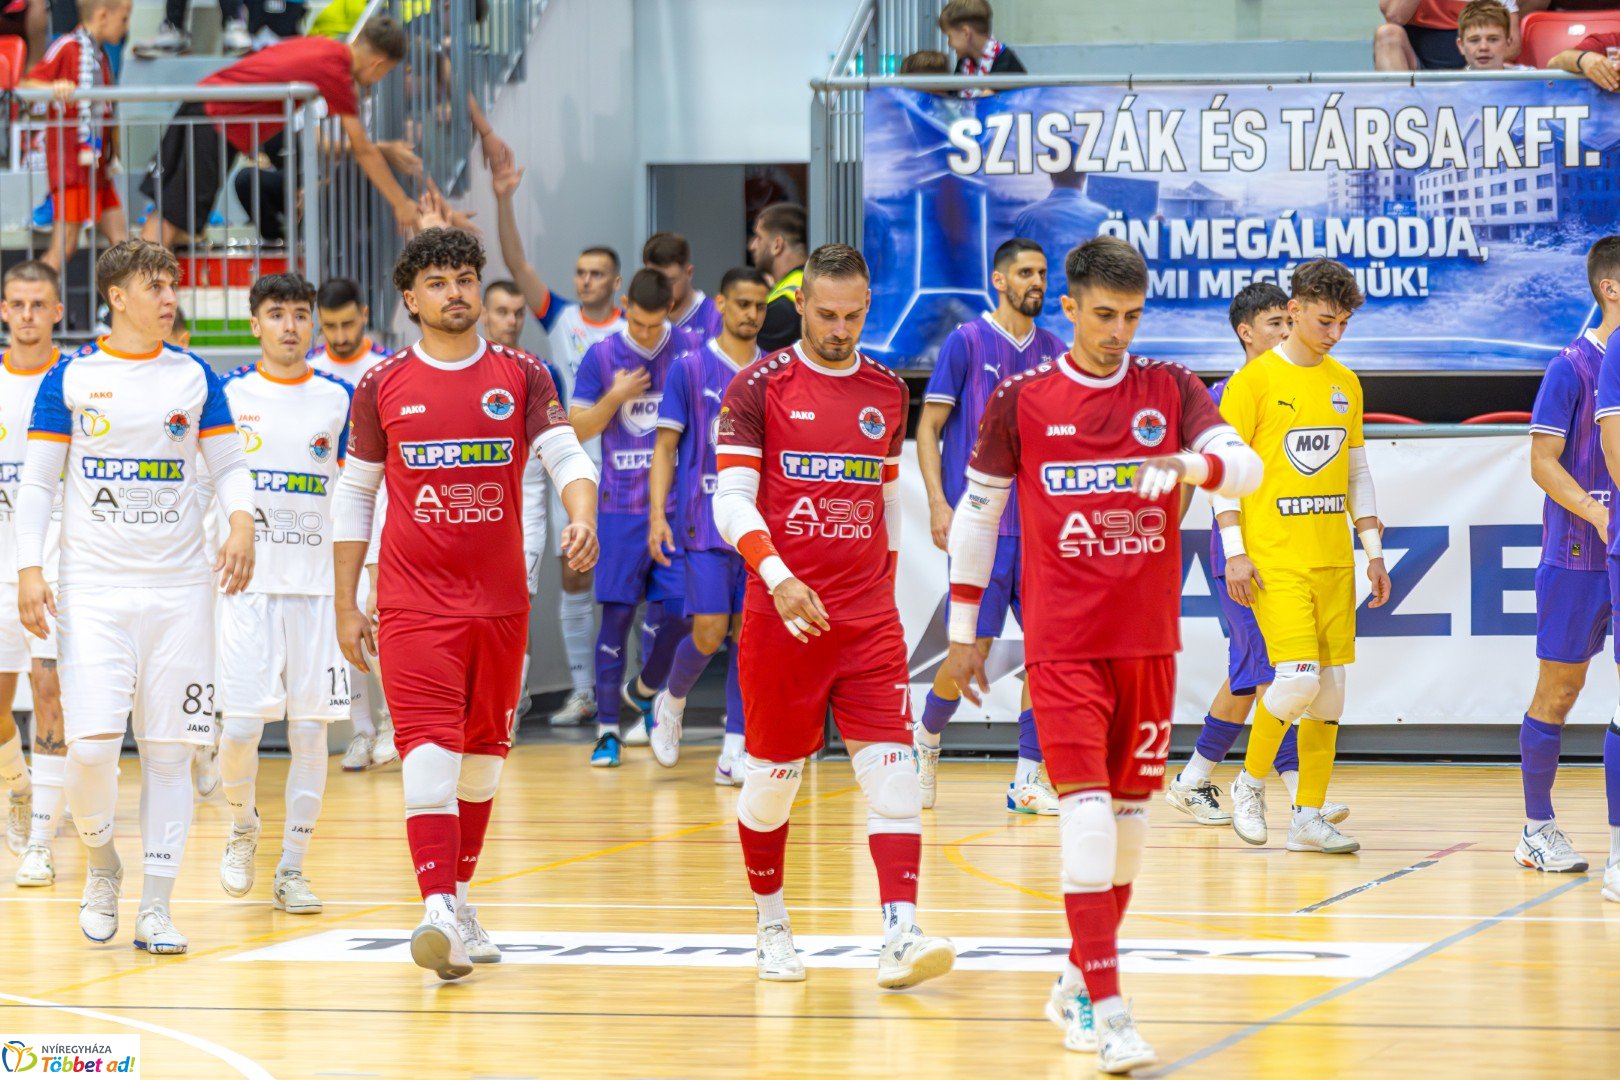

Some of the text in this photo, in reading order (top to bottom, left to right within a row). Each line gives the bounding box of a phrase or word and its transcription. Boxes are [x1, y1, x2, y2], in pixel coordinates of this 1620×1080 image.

[948, 92, 1601, 175] SZISZÁK ÉS TÁRSA KFT.
[1170, 209, 1489, 263] MEGÁLMODJA,
[89, 391, 113, 400] JAKO
[238, 414, 261, 422] JAKO
[401, 404, 427, 416] JAKO
[790, 410, 816, 421] JAKO
[1047, 424, 1076, 437] JAKO
[1296, 435, 1331, 452] MOL
[91, 509, 180, 524] STUDIO
[414, 507, 504, 524] STUDIO
[785, 520, 873, 539] STUDIO
[1058, 535, 1166, 559] STUDIO
[327, 666, 350, 696] 11
[182, 683, 215, 717] 83
[329, 698, 351, 706] JAKO
[187, 723, 210, 733] JAKO
[1134, 720, 1172, 760] 22
[1138, 764, 1165, 777] JAKO
